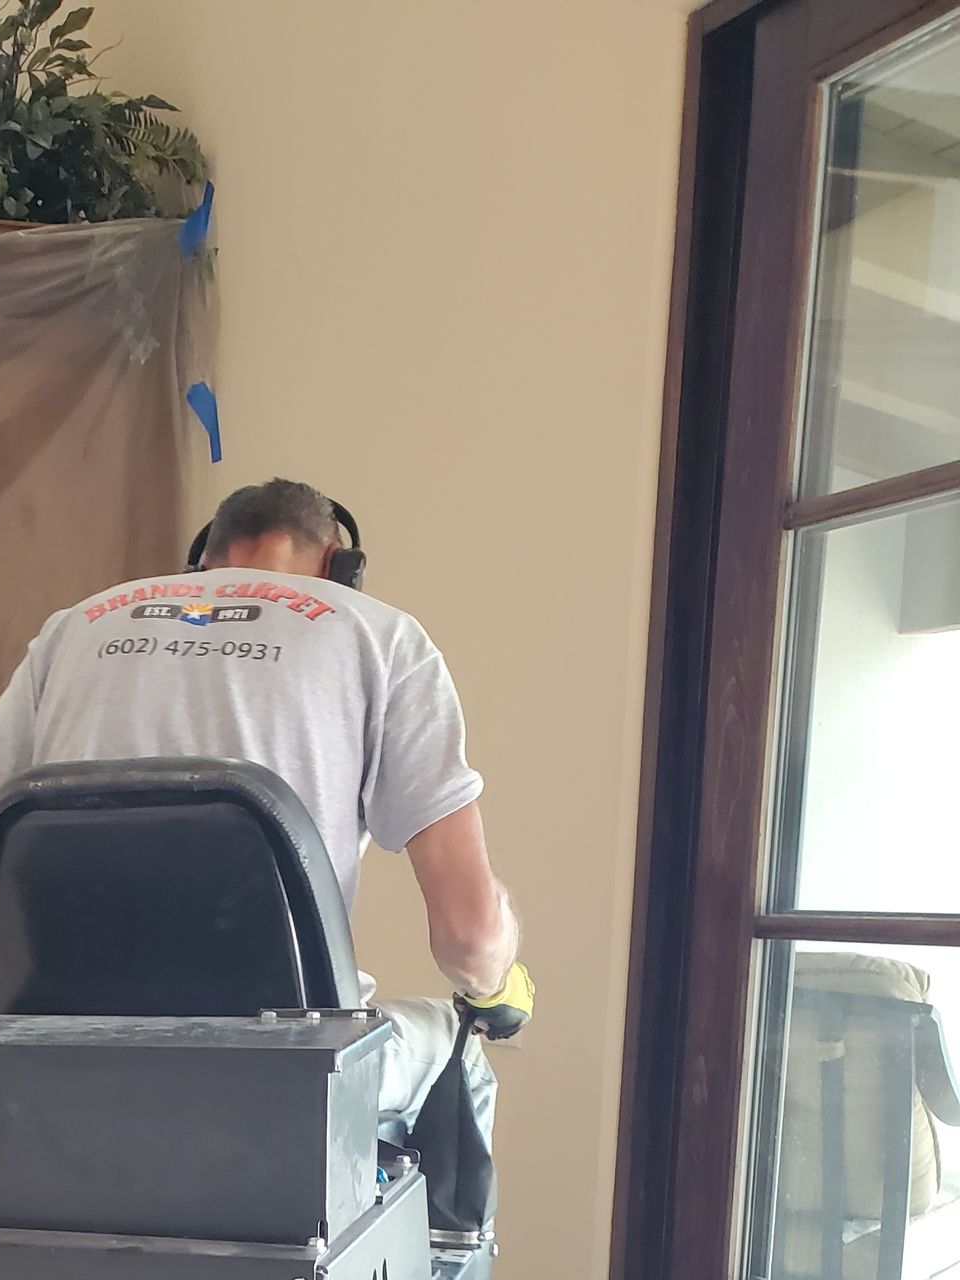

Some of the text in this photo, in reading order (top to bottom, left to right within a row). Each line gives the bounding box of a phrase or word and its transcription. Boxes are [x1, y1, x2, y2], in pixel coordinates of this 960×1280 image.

[143, 606, 248, 619] EST. 1971
[215, 582, 333, 621] CARPET
[98, 637, 282, 661] (602) 475-0931
